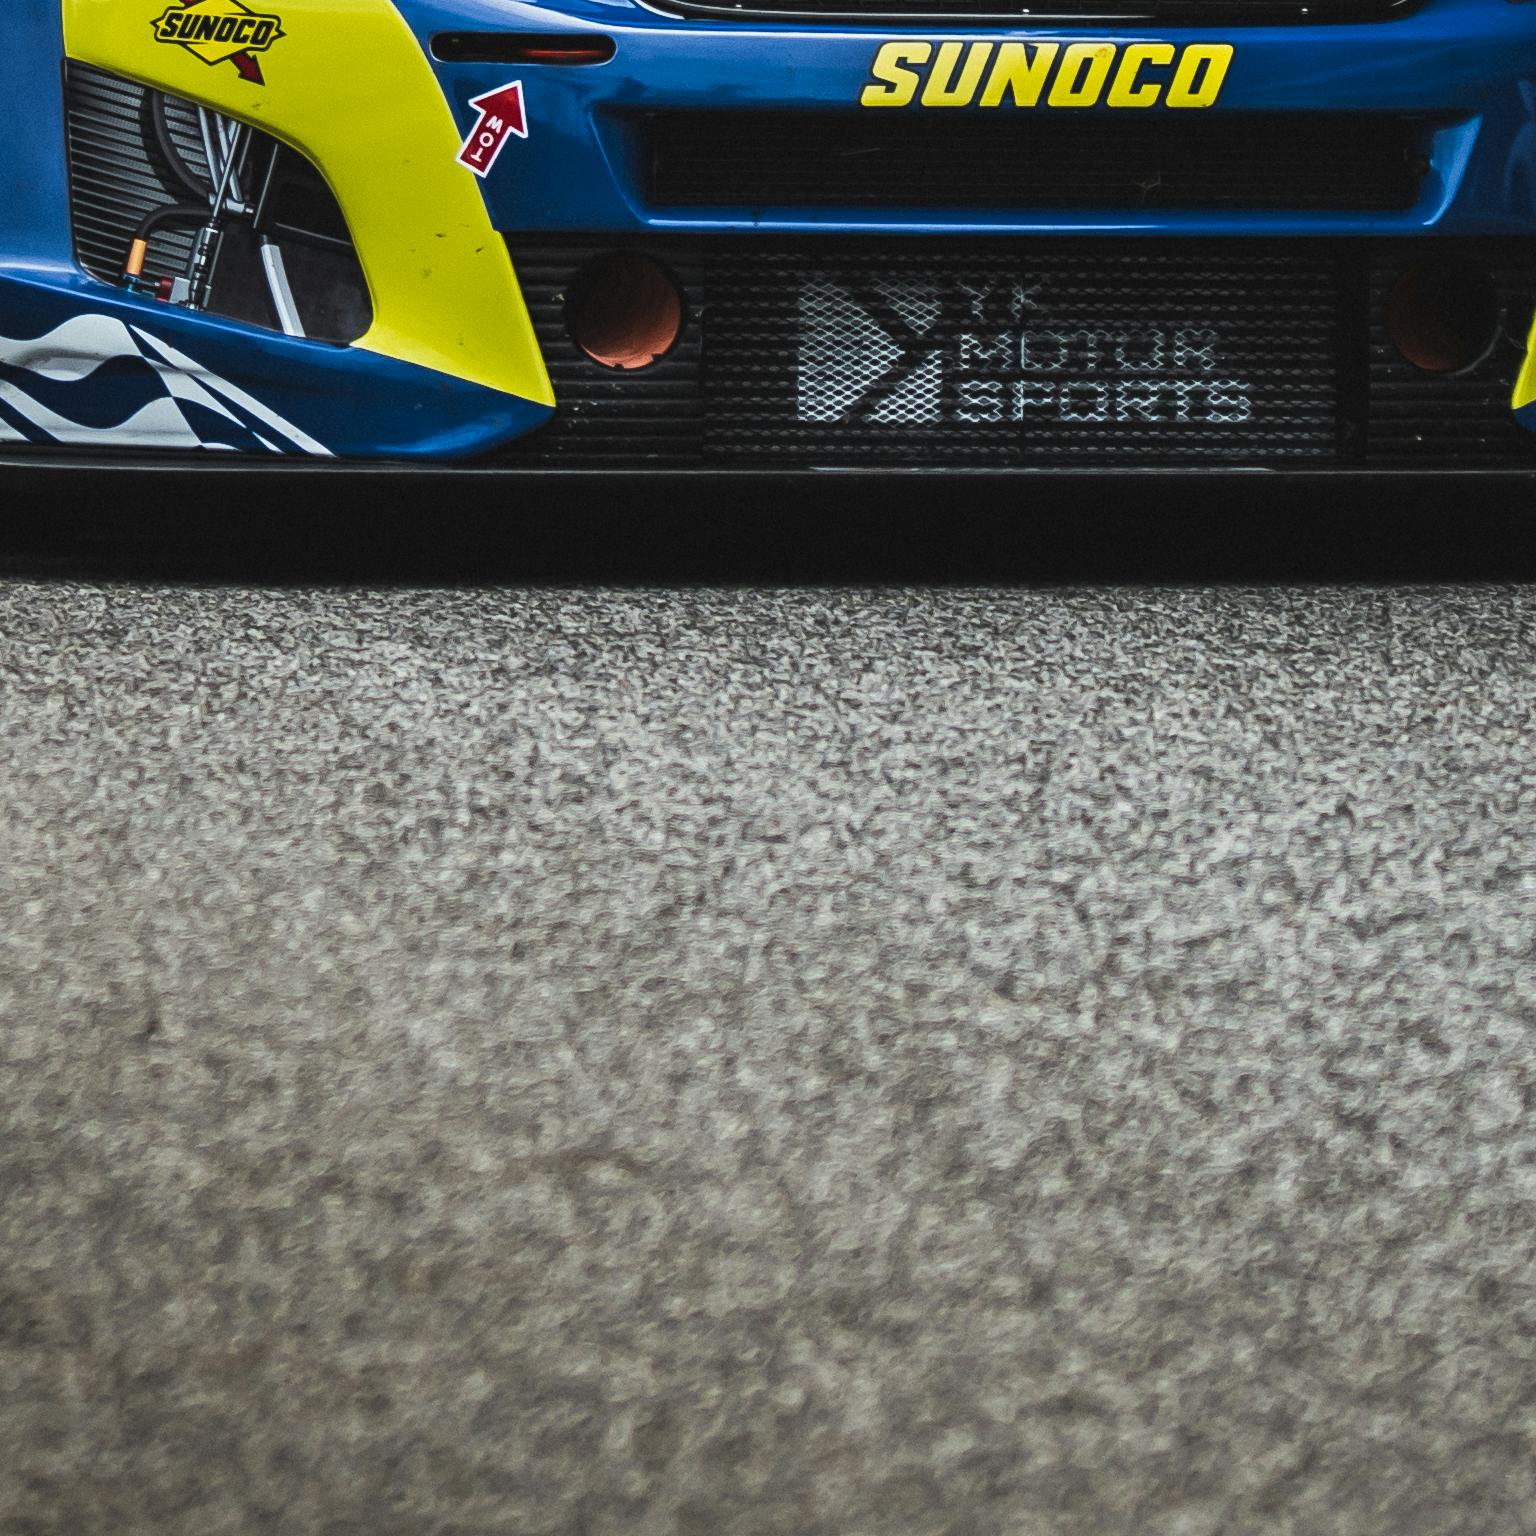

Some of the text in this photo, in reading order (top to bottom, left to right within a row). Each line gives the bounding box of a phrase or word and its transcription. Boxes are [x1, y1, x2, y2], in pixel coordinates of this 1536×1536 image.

[160, 12, 275, 45] SUNOCO
[861, 41, 1235, 108] SUNOCO
[956, 379, 1251, 423] SPORTS
